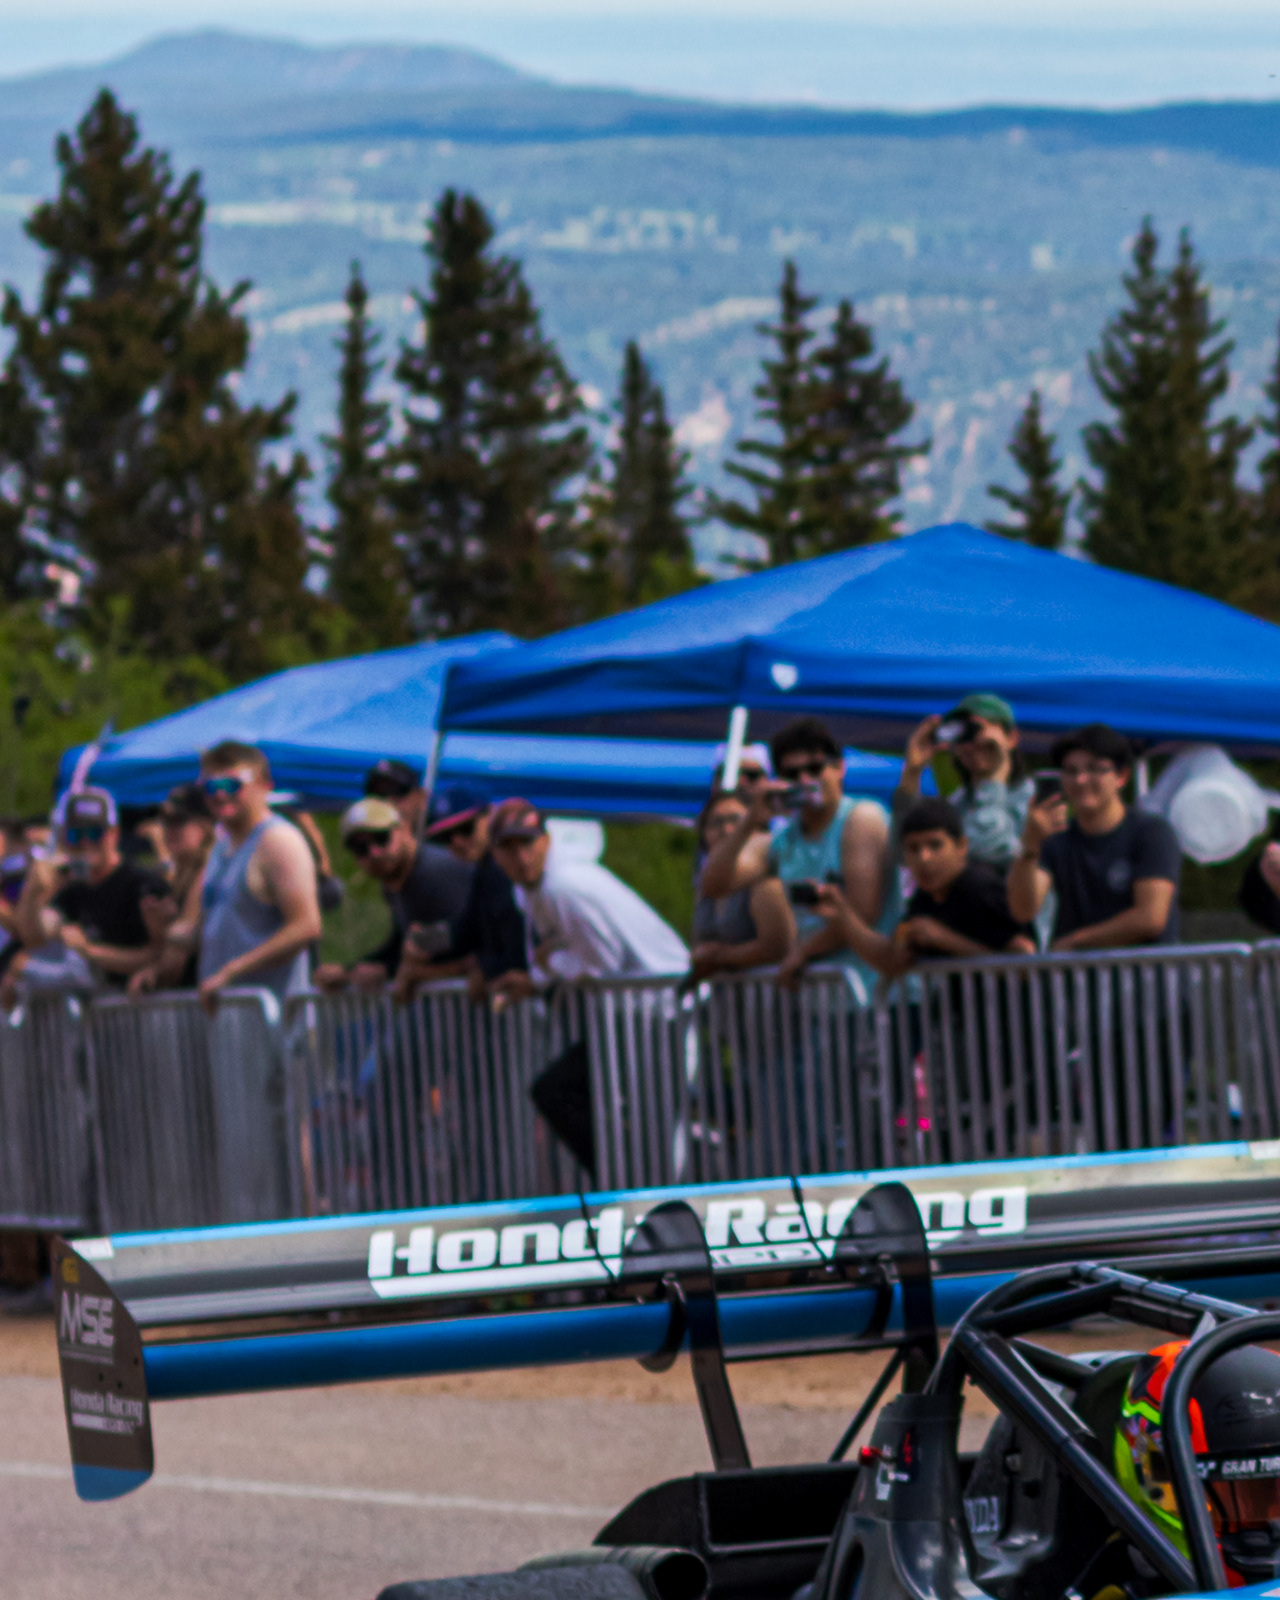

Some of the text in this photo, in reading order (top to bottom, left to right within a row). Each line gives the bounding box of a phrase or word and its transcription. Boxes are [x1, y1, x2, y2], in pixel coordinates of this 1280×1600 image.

[368, 1206, 648, 1278] Hond
[60, 1289, 116, 1348] MSE
[1222, 1459, 1257, 1475] GRAN
